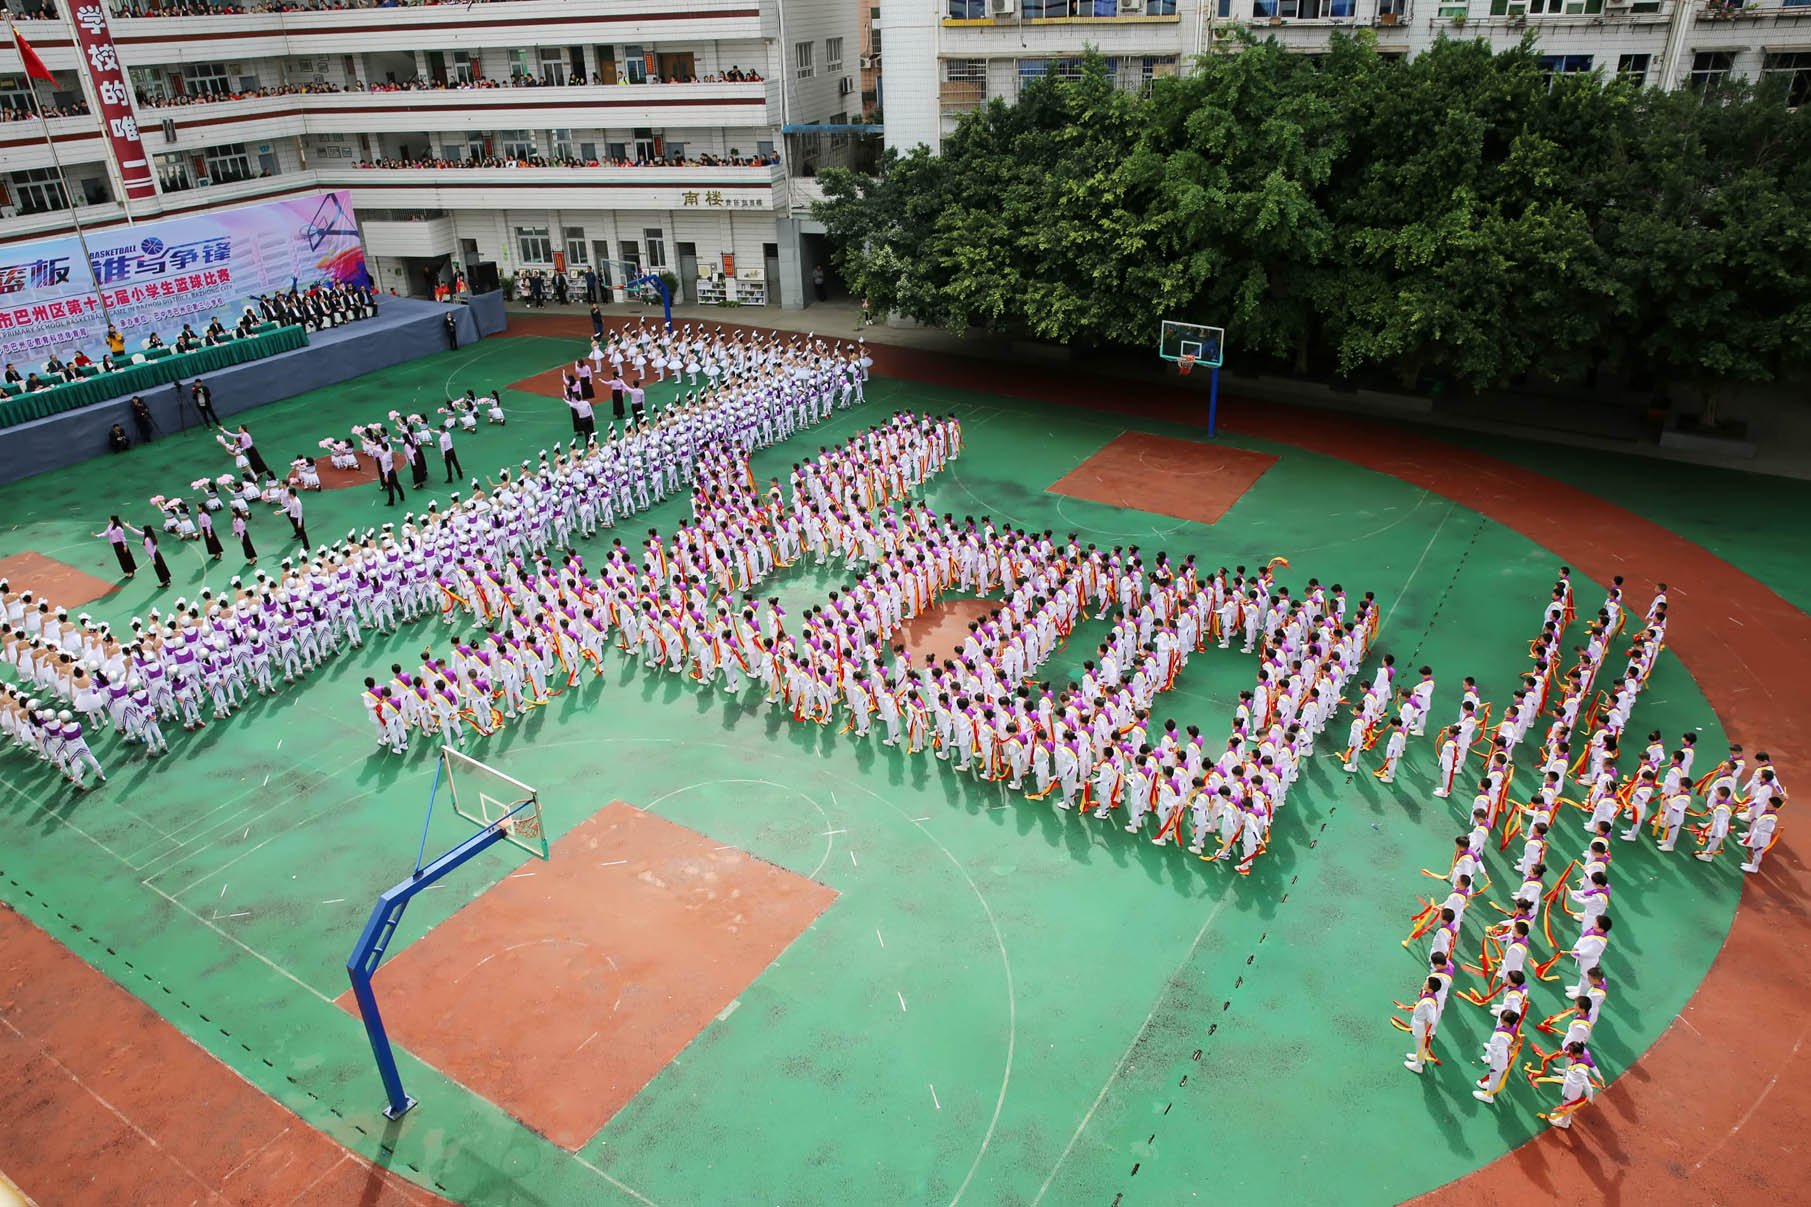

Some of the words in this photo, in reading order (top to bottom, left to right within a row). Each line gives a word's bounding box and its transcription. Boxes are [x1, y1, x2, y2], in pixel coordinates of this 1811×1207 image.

[77, 5, 147, 168] 学校的唯一
[681, 190, 723, 207] 南楼
[90, 246, 136, 259] BASKETBALL
[91, 236, 231, 286] 谁与争锋
[3, 327, 36, 338] PRIMARY
[37, 322, 64, 334] SCHOOL
